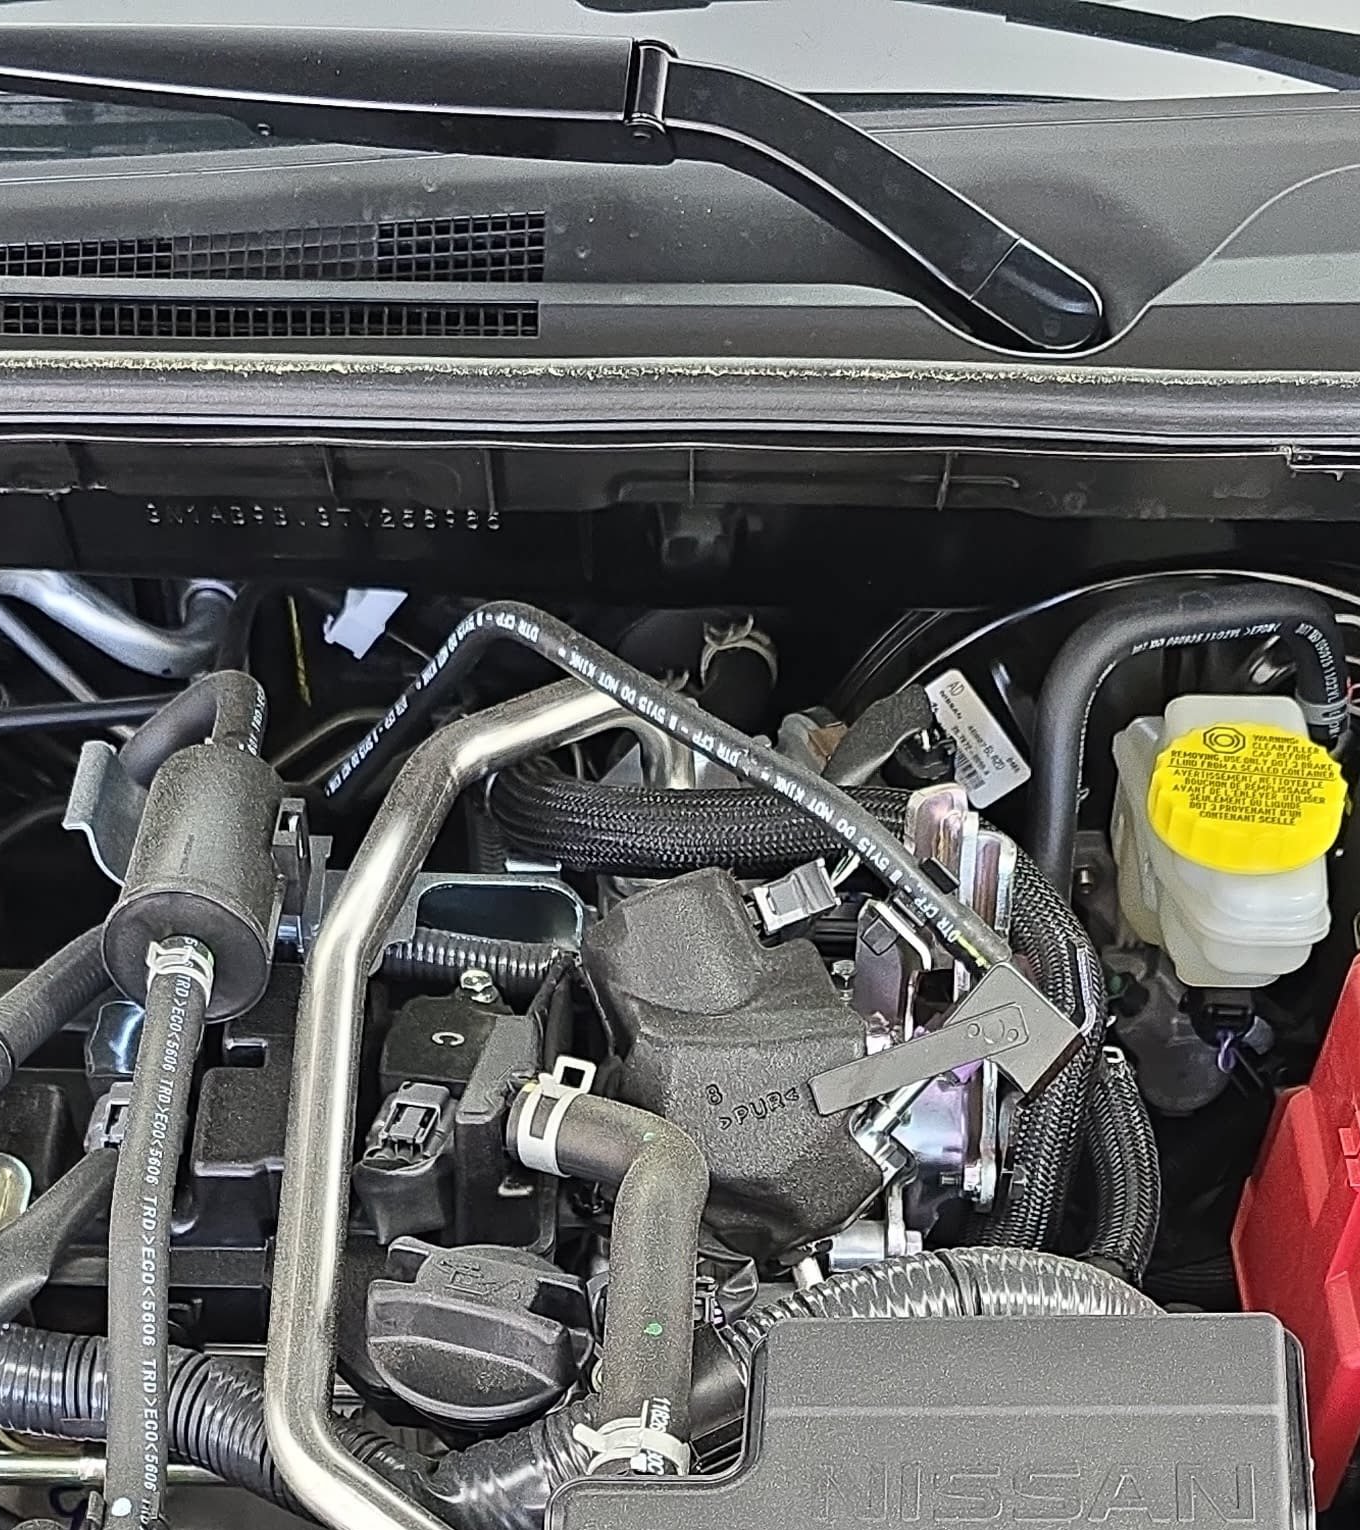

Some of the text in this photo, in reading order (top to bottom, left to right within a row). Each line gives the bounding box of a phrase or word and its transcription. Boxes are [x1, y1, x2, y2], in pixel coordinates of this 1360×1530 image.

[597, 675, 619, 695] NOT
[805, 799, 835, 823] NOT
[705, 1084, 723, 1105] 8
[815, 1462, 1257, 1524] NISSAN
